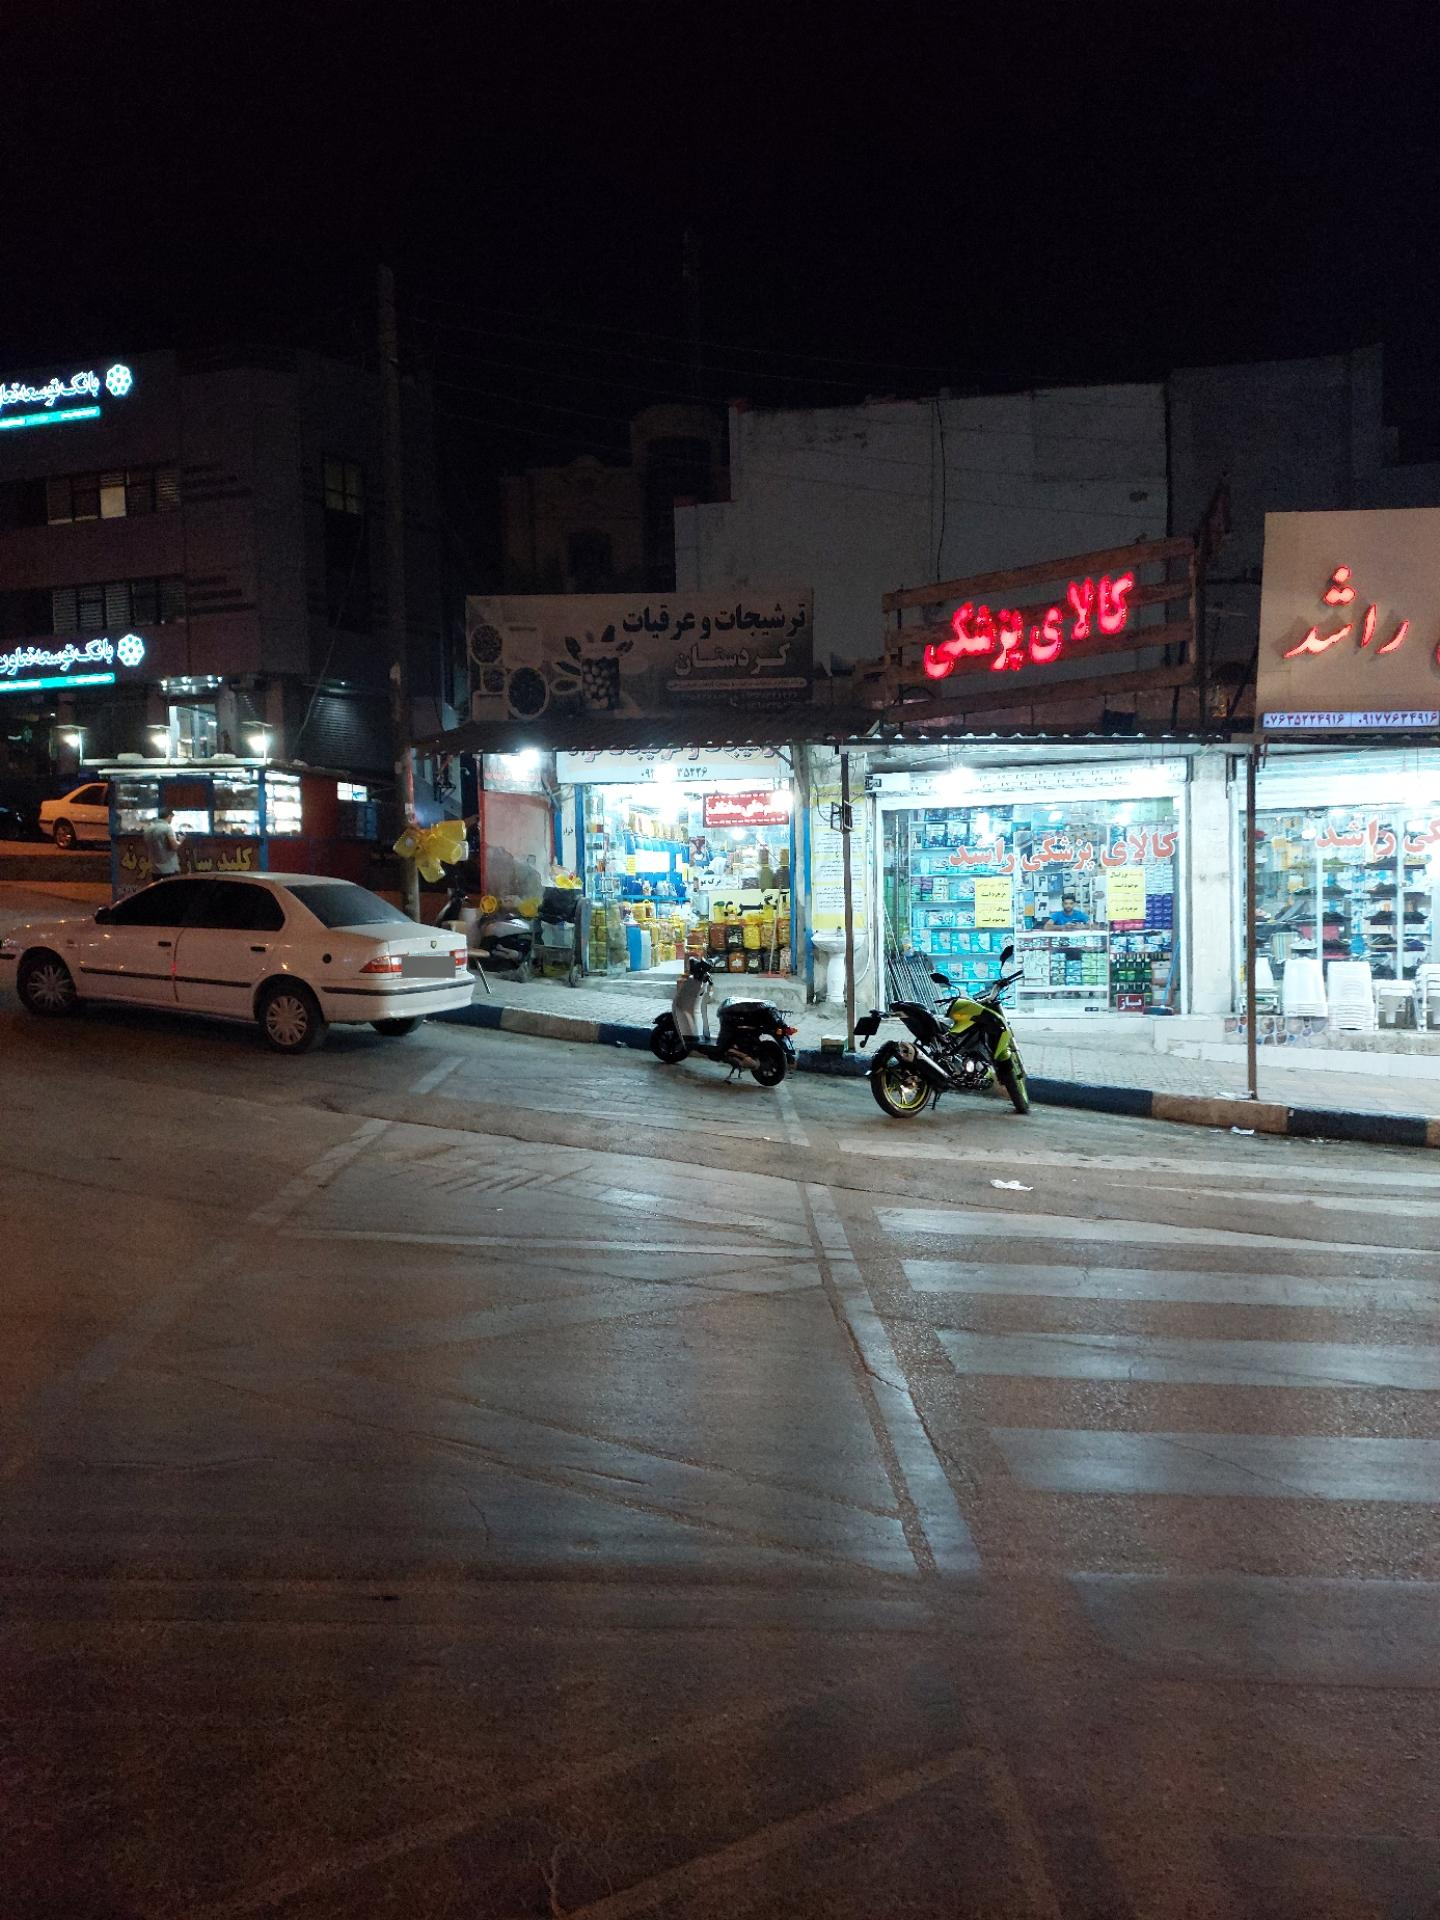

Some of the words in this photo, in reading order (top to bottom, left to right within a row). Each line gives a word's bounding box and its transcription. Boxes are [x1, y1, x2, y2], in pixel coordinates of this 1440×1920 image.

[20, 377, 61, 407] توسعه
[61, 370, 100, 397] بانک
[622, 604, 695, 640] عرقیات
[700, 616, 710, 639] و
[714, 603, 805, 637] ترشیجات
[1029, 571, 1135, 664] کالای
[1283, 564, 1409, 659] راشد
[75, 638, 114, 664] بانک
[923, 600, 1024, 679] پزشکی
[35, 644, 75, 671] توسعه
[675, 641, 791, 676] کردستان
[949, 836, 1017, 873] راشد
[1020, 834, 1095, 871] پزشکی
[1100, 831, 1179, 867] کالای
[1316, 818, 1396, 858] راشد
[1119, 996, 1142, 1010] باز
